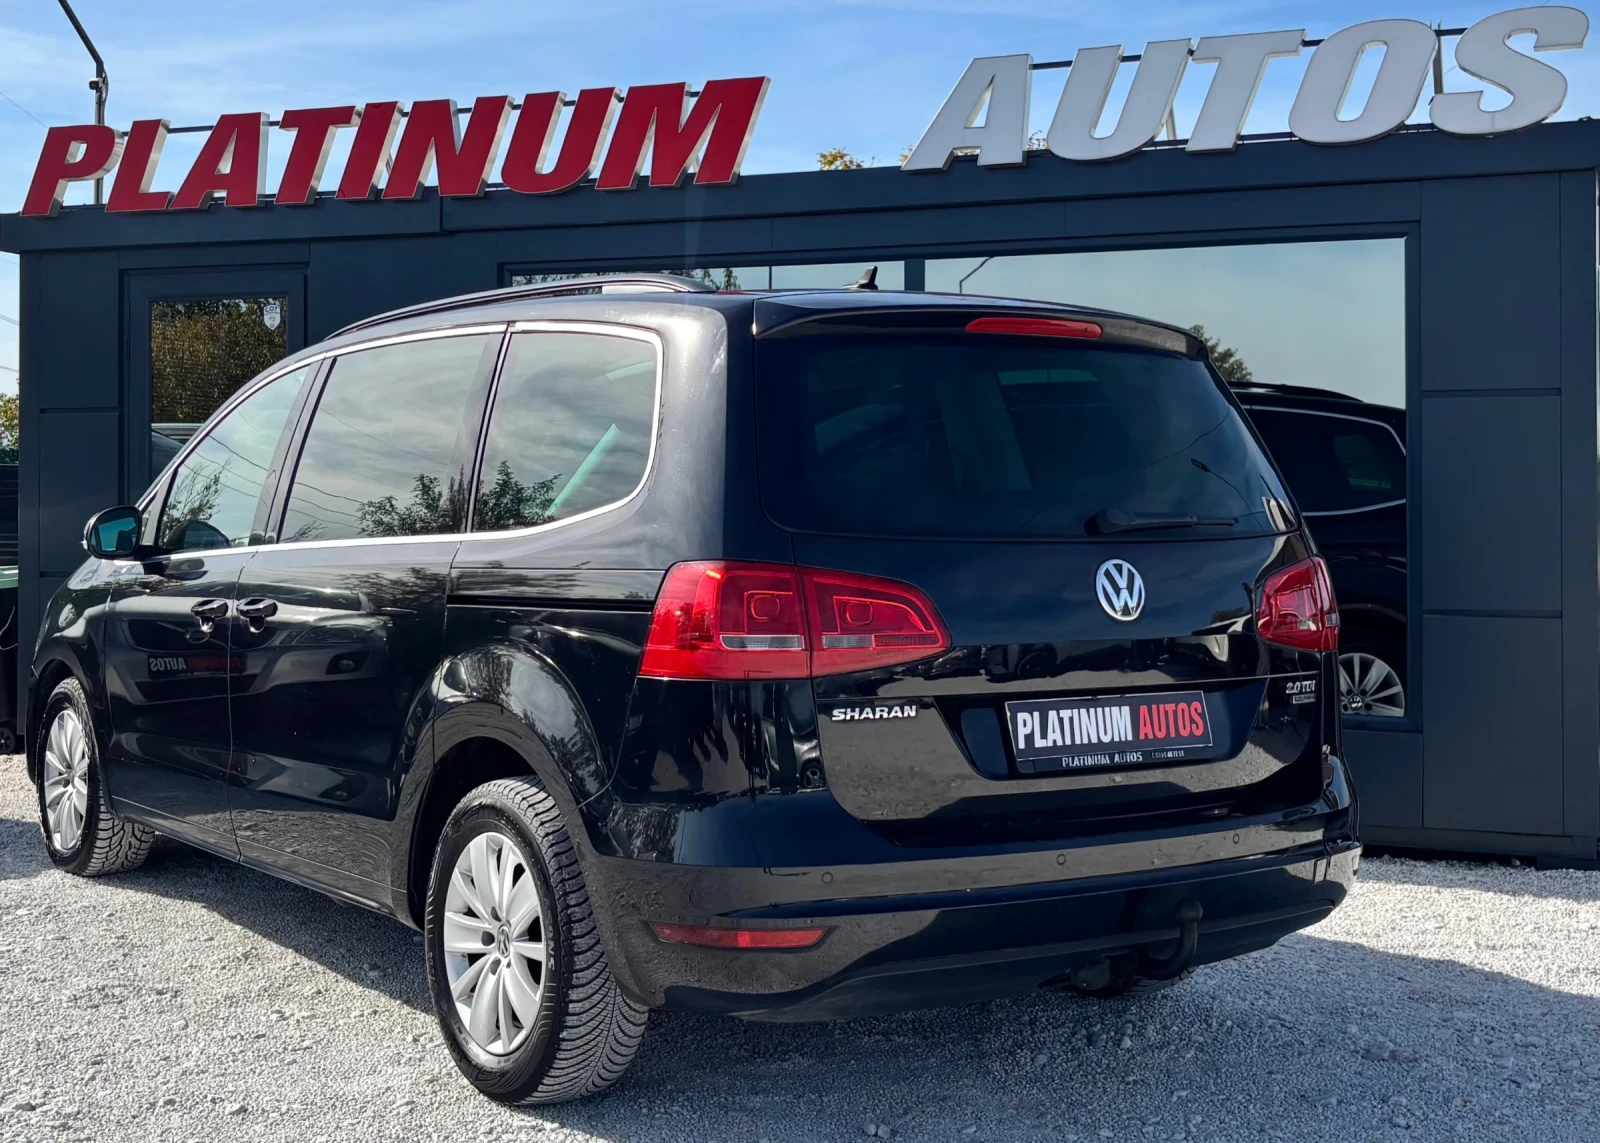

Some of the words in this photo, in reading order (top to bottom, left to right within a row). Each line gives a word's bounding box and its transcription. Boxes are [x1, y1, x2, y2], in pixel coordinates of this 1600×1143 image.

[20, 75, 771, 217] PLATINUM
[901, 5, 1589, 171] AUTOS
[1096, 559, 1145, 621] VW
[831, 705, 917, 721] SHARAN
[1017, 706, 1133, 749] PLATINUM
[1139, 701, 1204, 740] AUTOS
[1062, 753, 1111, 768] PLATINUM
[1113, 751, 1143, 764] AUTOS
